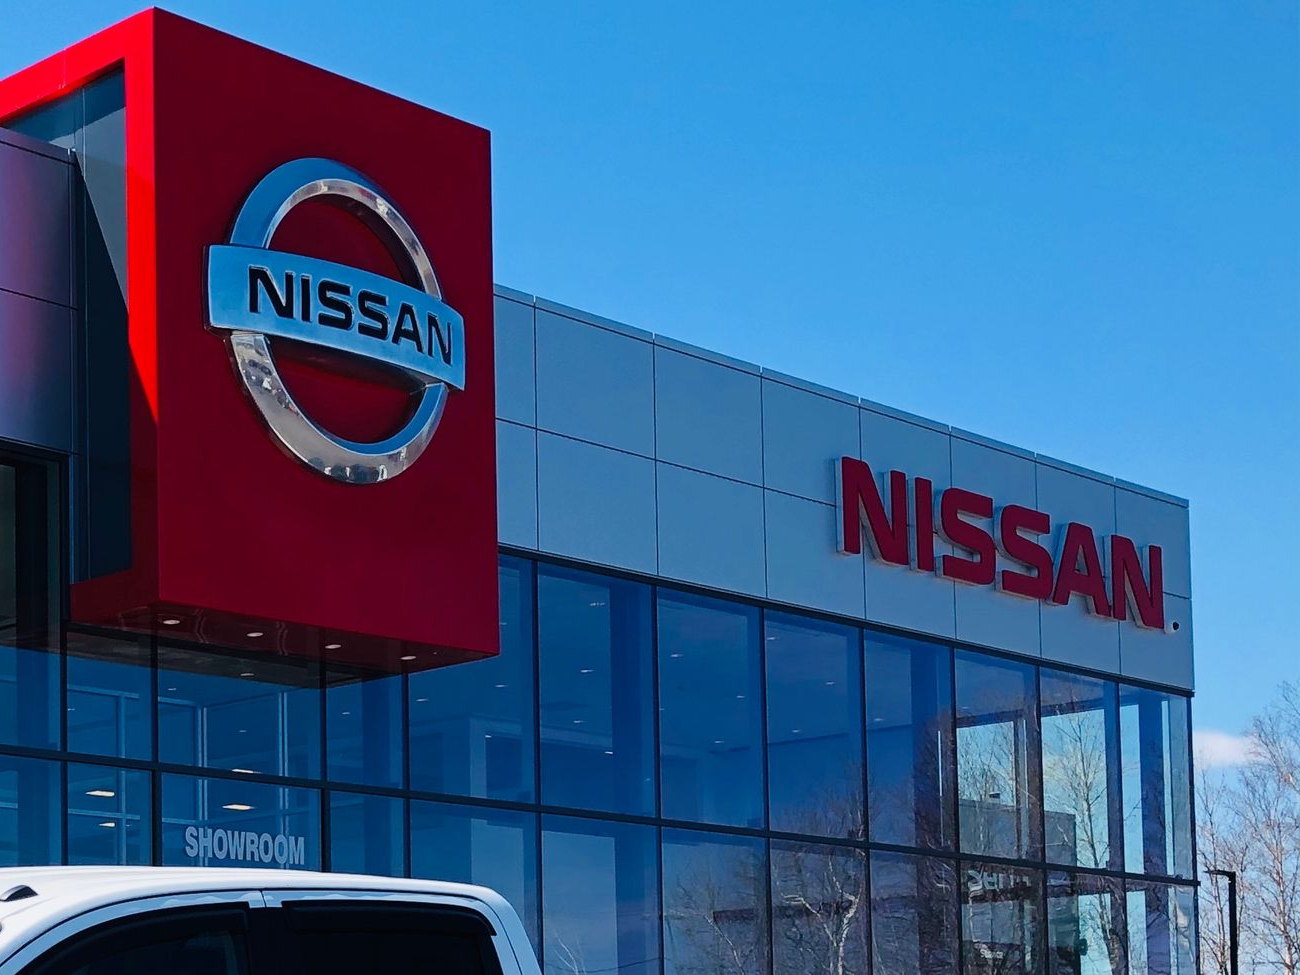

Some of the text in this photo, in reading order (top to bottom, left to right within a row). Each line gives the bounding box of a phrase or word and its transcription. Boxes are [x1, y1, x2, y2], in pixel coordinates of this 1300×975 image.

[248, 264, 452, 367] NISSAN
[836, 456, 1165, 630] NISSAN
[185, 826, 305, 865] SHOWROOM
